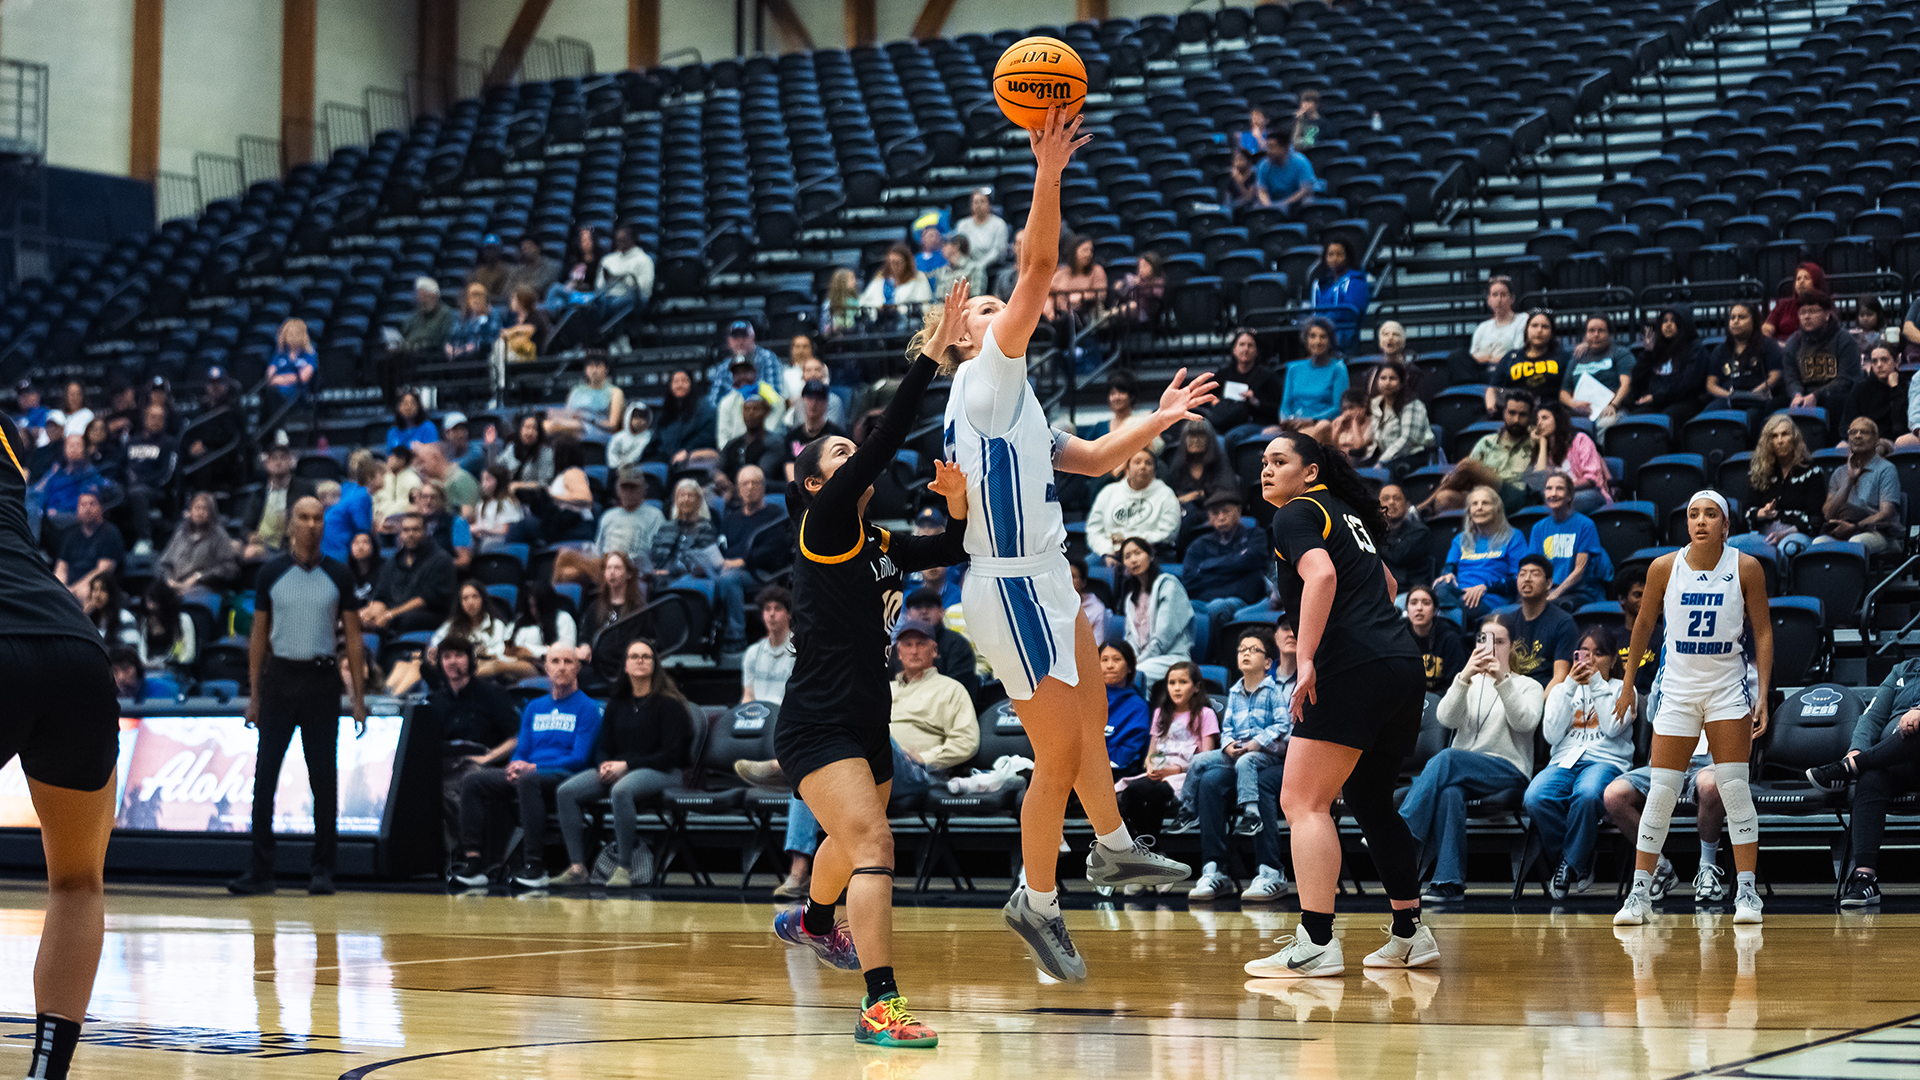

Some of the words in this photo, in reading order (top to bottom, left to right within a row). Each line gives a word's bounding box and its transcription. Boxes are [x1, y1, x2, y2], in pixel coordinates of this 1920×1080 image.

[1008, 80, 1071, 99] Wilson
[1343, 513, 1377, 555] 13
[881, 589, 904, 636] 10
[1680, 592, 1724, 606] SANTA
[1687, 610, 1717, 637] 23
[1675, 640, 1733, 655] BARBARA
[139, 749, 255, 803] Aloh
